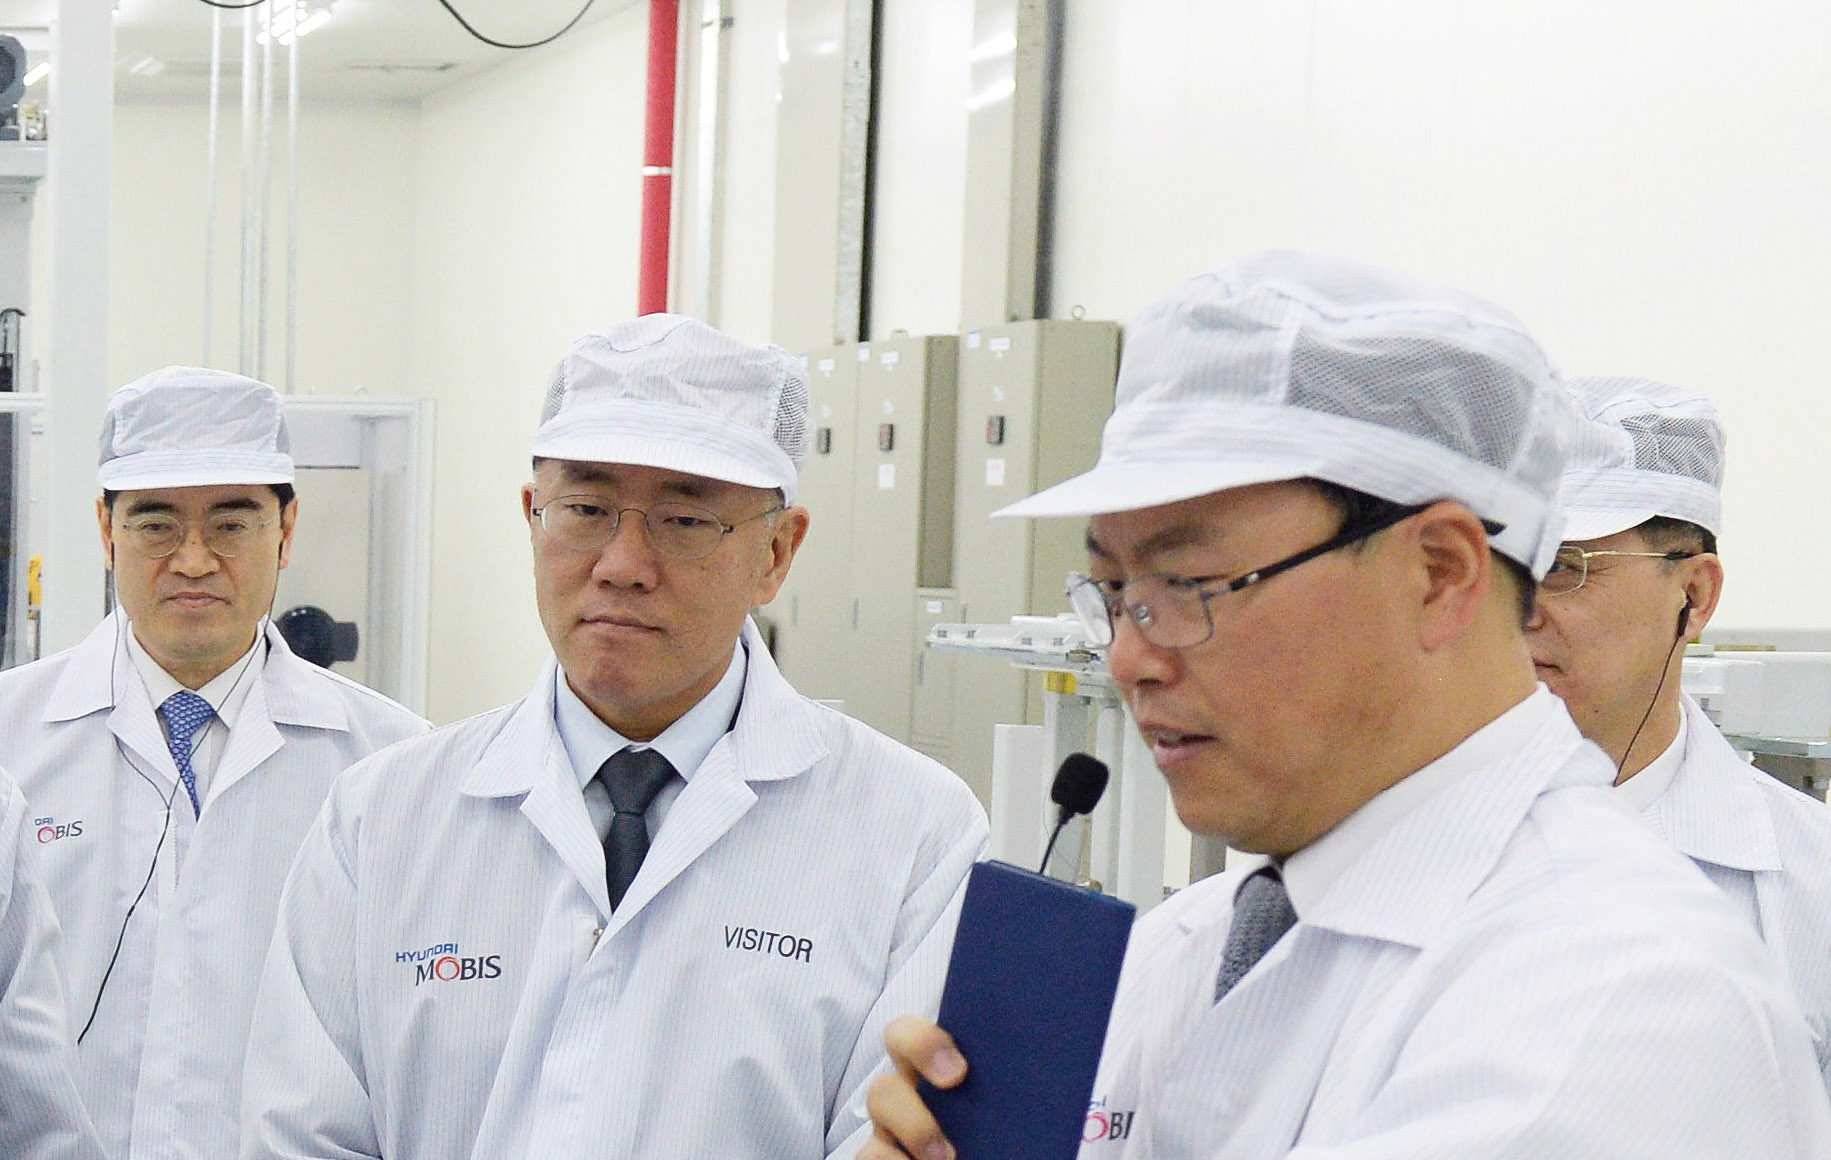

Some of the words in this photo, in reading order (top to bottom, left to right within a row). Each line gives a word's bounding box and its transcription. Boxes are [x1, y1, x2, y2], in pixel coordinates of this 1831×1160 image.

[37, 820, 83, 844] OBIS
[395, 943, 459, 962] HYUNDAI
[725, 925, 813, 963] VISITOR
[415, 955, 502, 986] MOBIS
[1082, 1111, 1135, 1143] OBI
